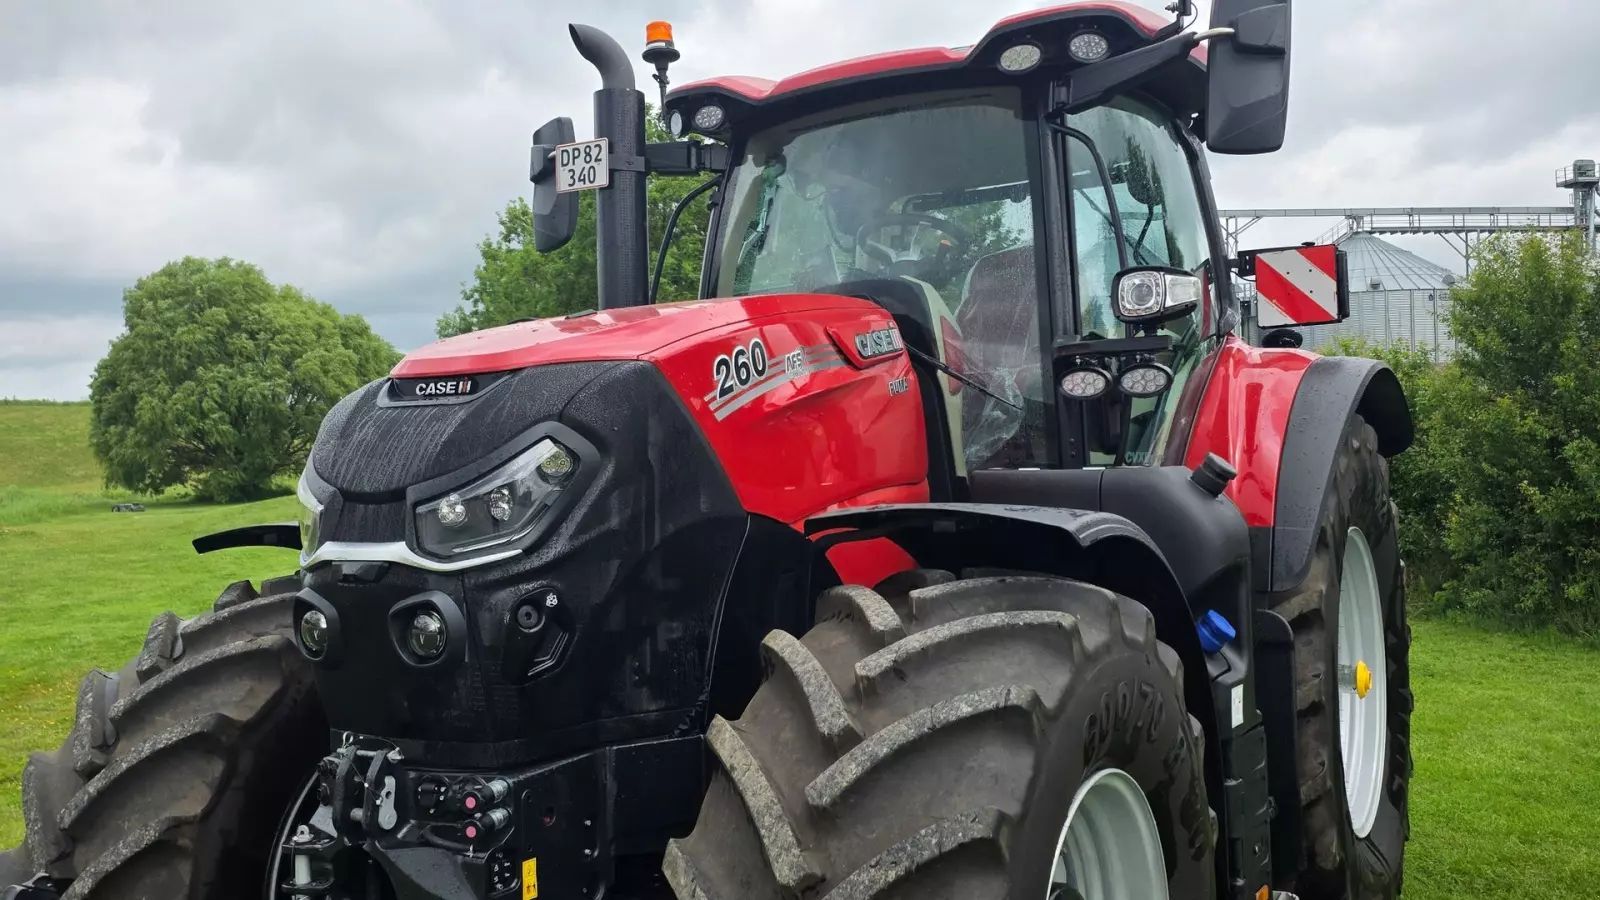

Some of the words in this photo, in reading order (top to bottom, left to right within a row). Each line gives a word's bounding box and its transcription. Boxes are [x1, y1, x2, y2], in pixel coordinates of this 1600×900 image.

[567, 165, 597, 188] 340
[855, 329, 894, 357] CASE
[713, 337, 769, 401] 260
[415, 381, 457, 396] CASE
